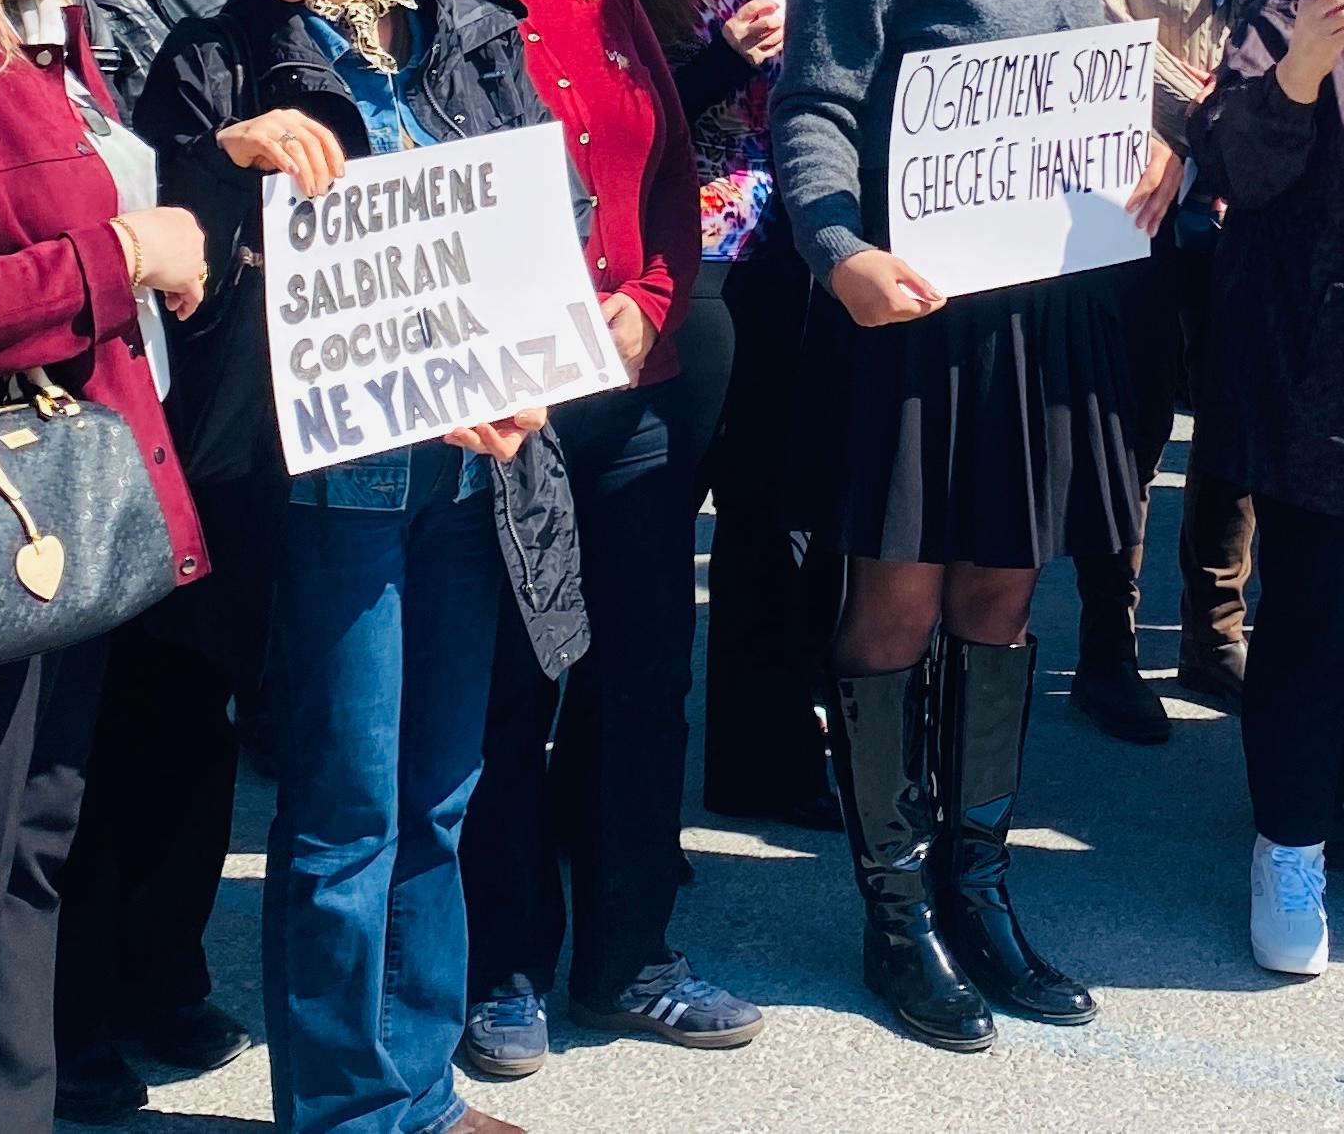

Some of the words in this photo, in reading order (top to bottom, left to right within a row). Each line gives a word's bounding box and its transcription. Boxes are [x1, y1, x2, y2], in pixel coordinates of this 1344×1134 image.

[902, 55, 1059, 134] ÖĞRETMENE
[901, 137, 1019, 220] GELECEĞE
[280, 231, 471, 325] SALDIRAN
[293, 384, 364, 454] NE
[364, 301, 609, 437] YAPMAZ!
